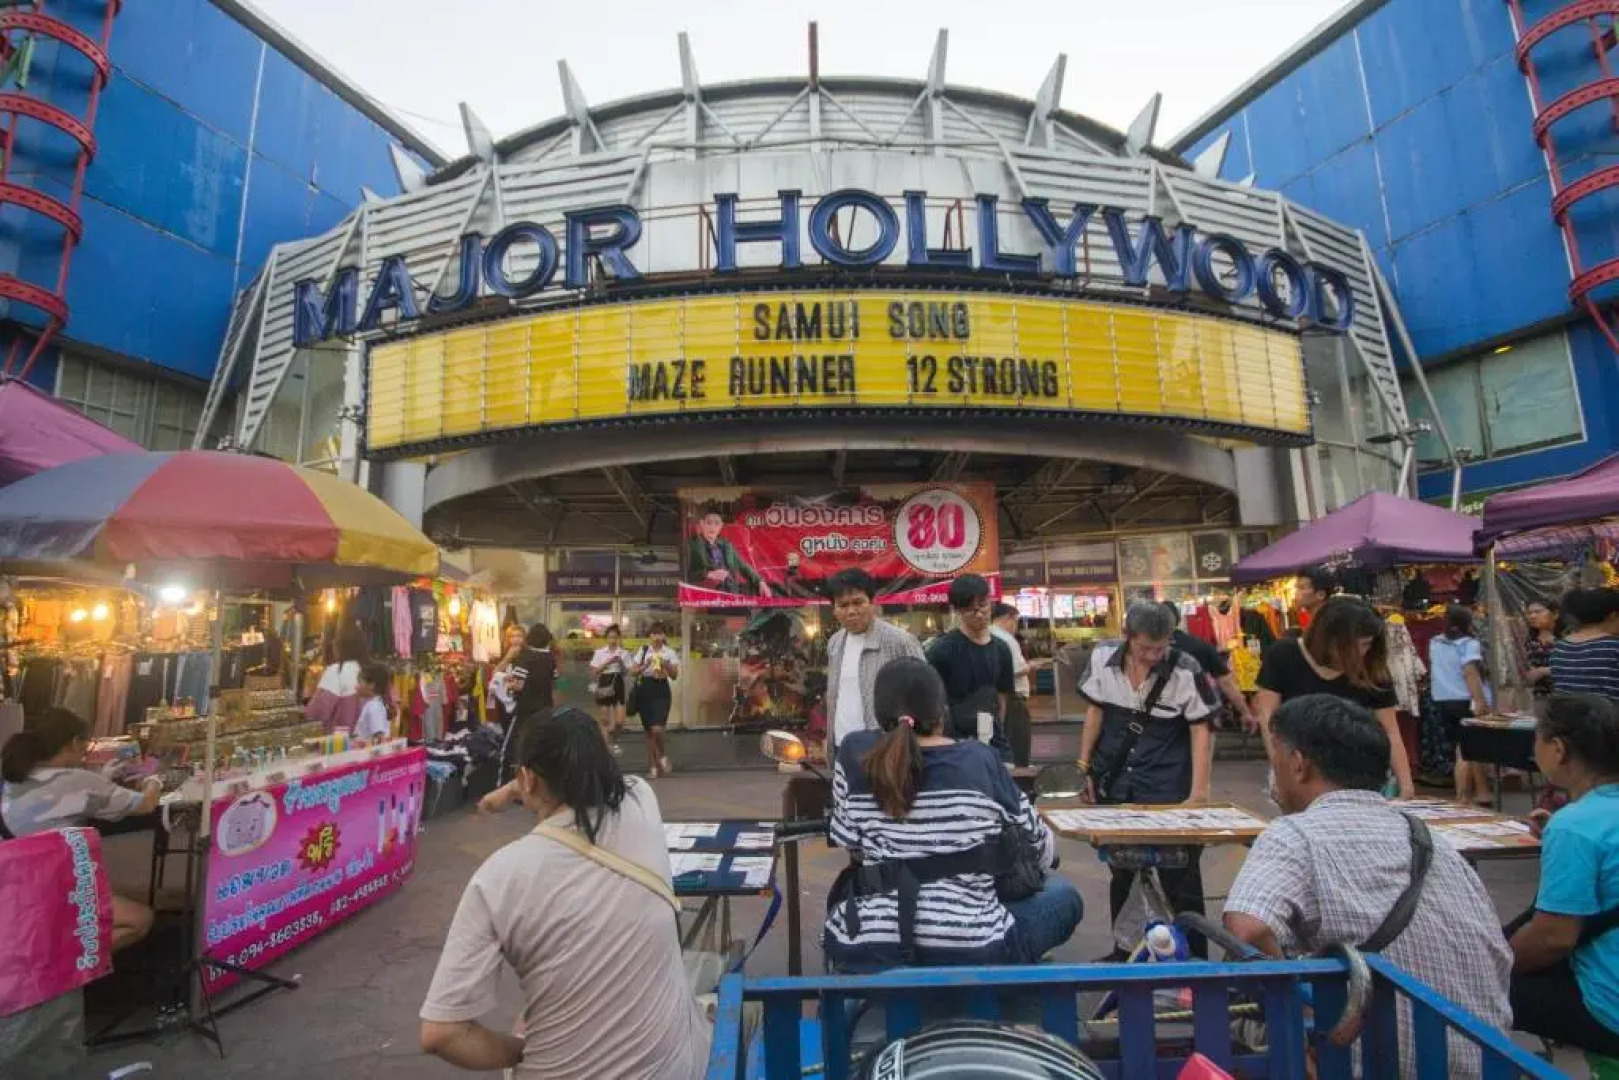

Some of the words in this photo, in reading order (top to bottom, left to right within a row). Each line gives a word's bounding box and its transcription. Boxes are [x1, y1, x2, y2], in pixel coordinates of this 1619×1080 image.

[293, 203, 642, 347] MAJOR
[715, 189, 1355, 332] HOLLYWOOD
[753, 300, 860, 342] SAMUI
[887, 300, 970, 340] SONG
[629, 358, 707, 401] MAZE
[729, 353, 857, 395] RUNNER
[906, 354, 937, 394] 12
[947, 355, 1059, 398] STRONG
[908, 502, 966, 550] 80
